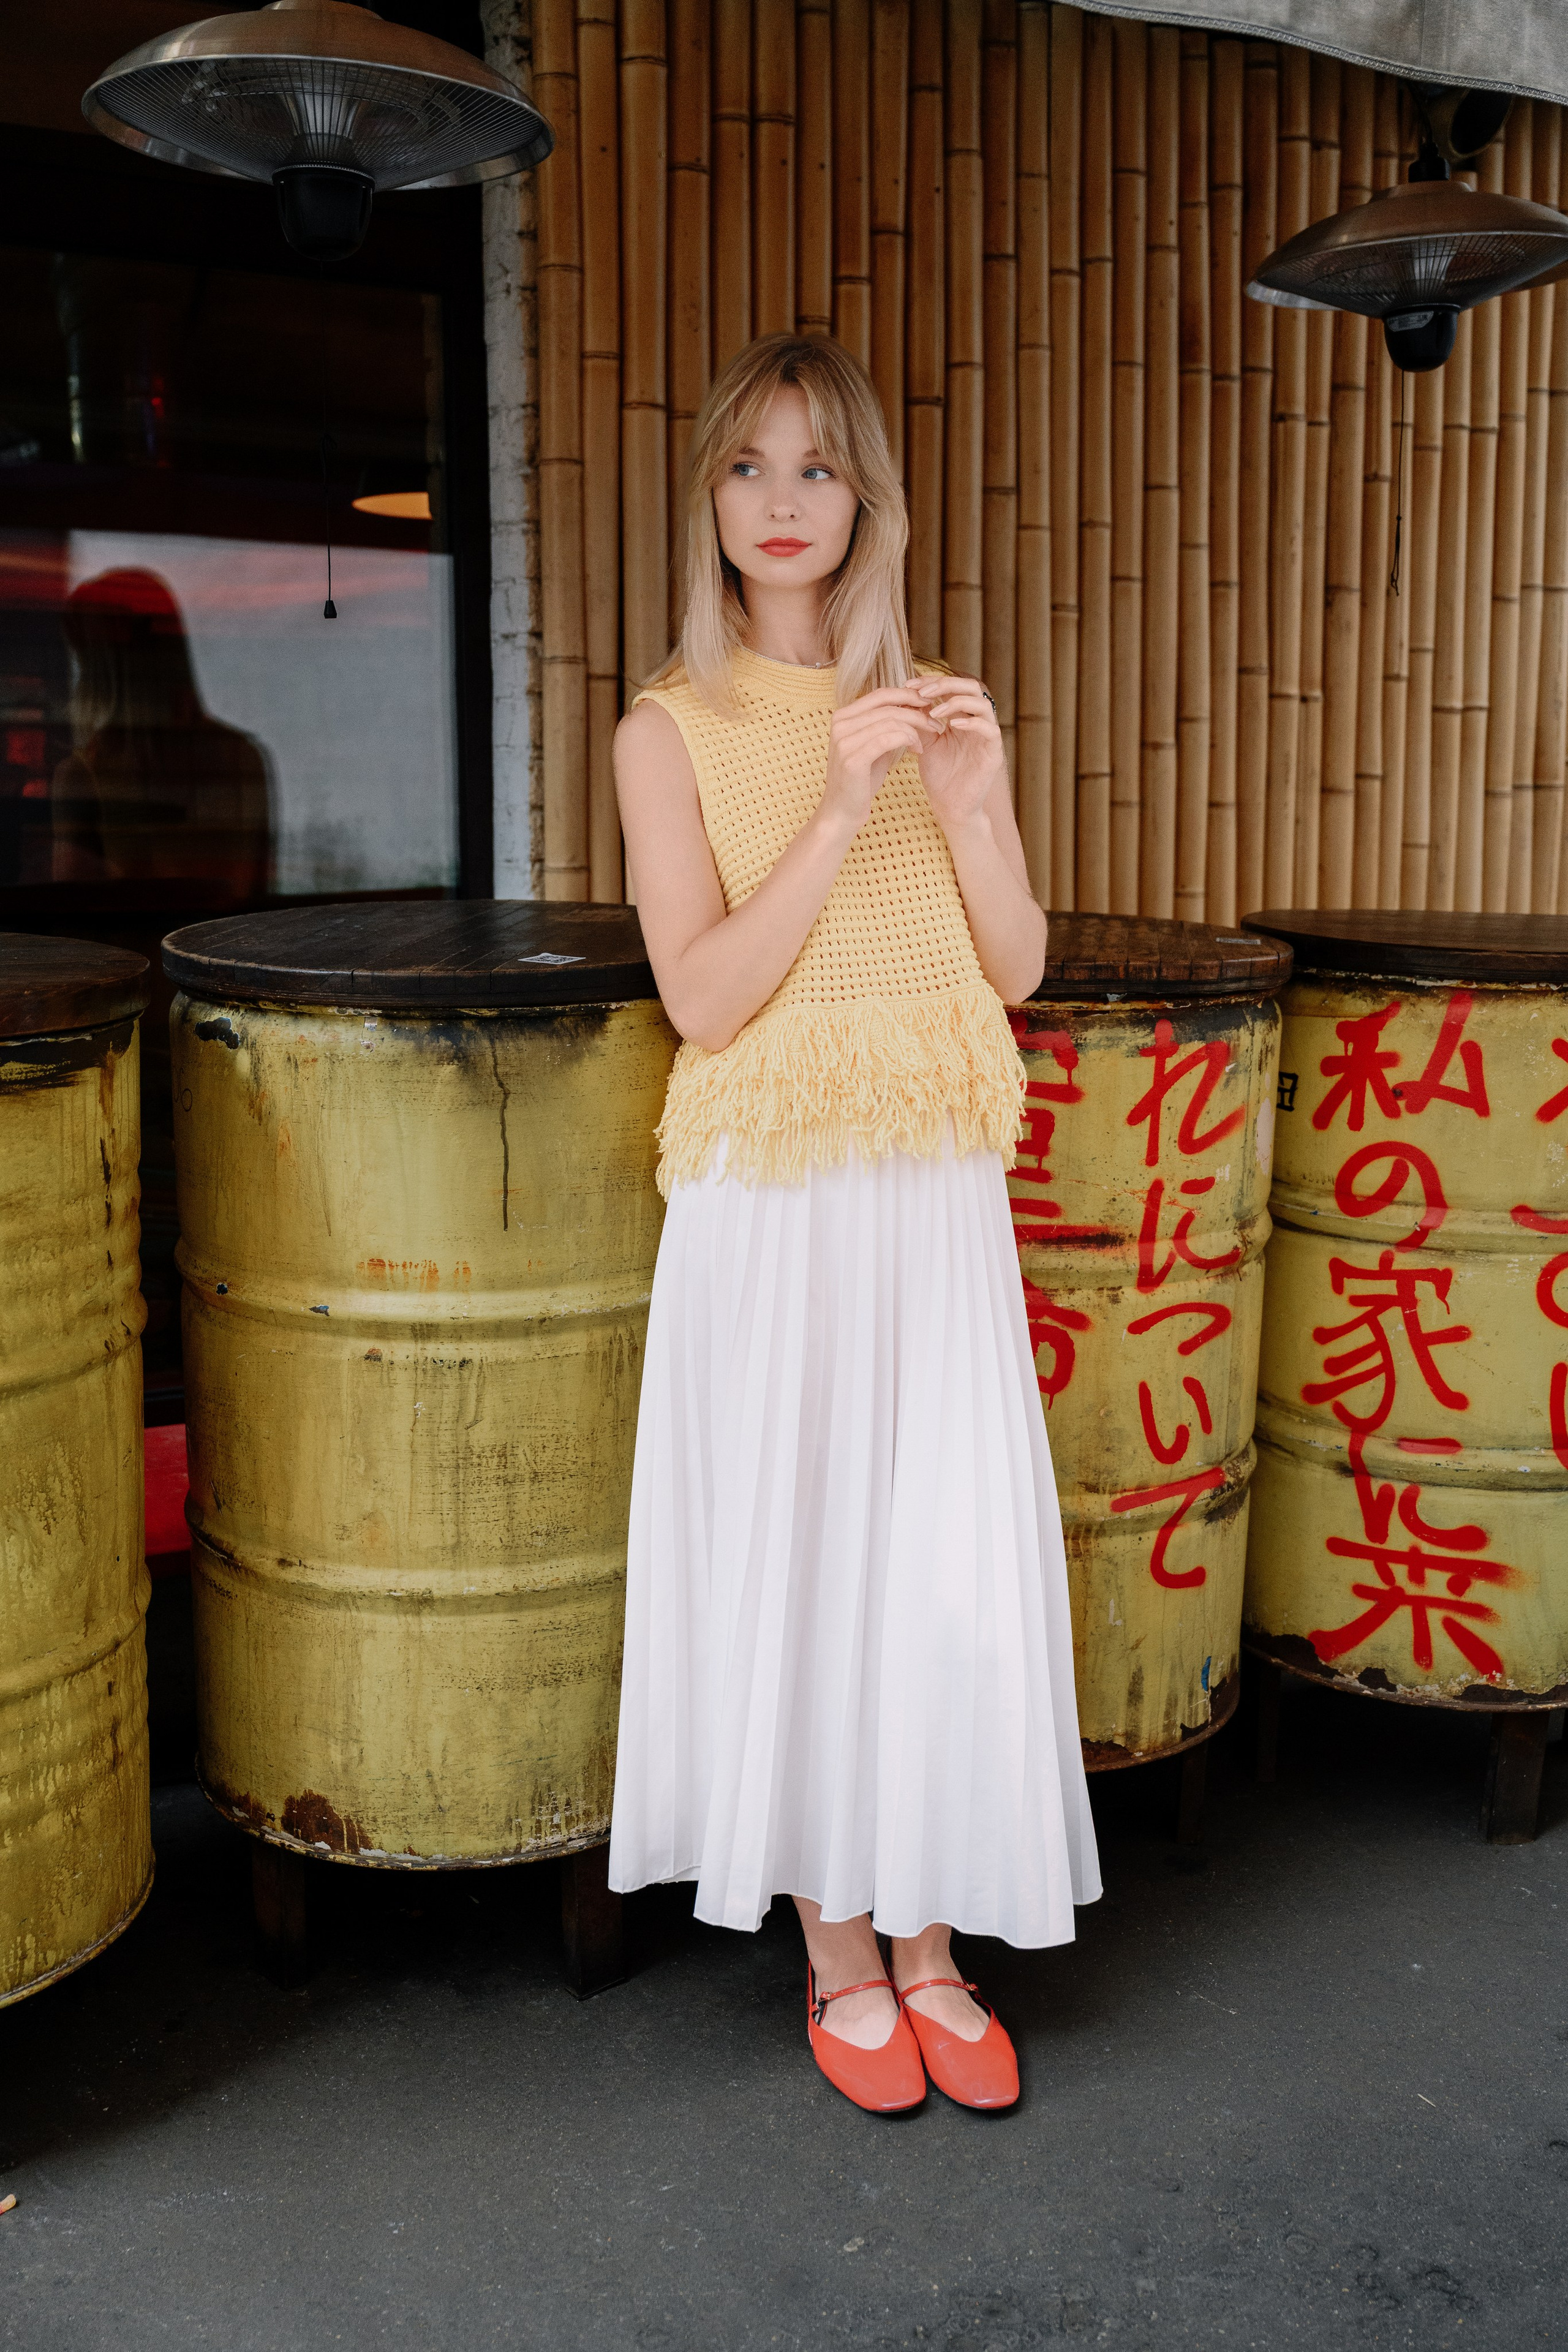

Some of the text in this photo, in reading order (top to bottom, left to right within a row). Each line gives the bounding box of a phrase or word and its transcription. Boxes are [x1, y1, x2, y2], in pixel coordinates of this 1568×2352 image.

[1110, 1019, 1246, 1589] れについて
